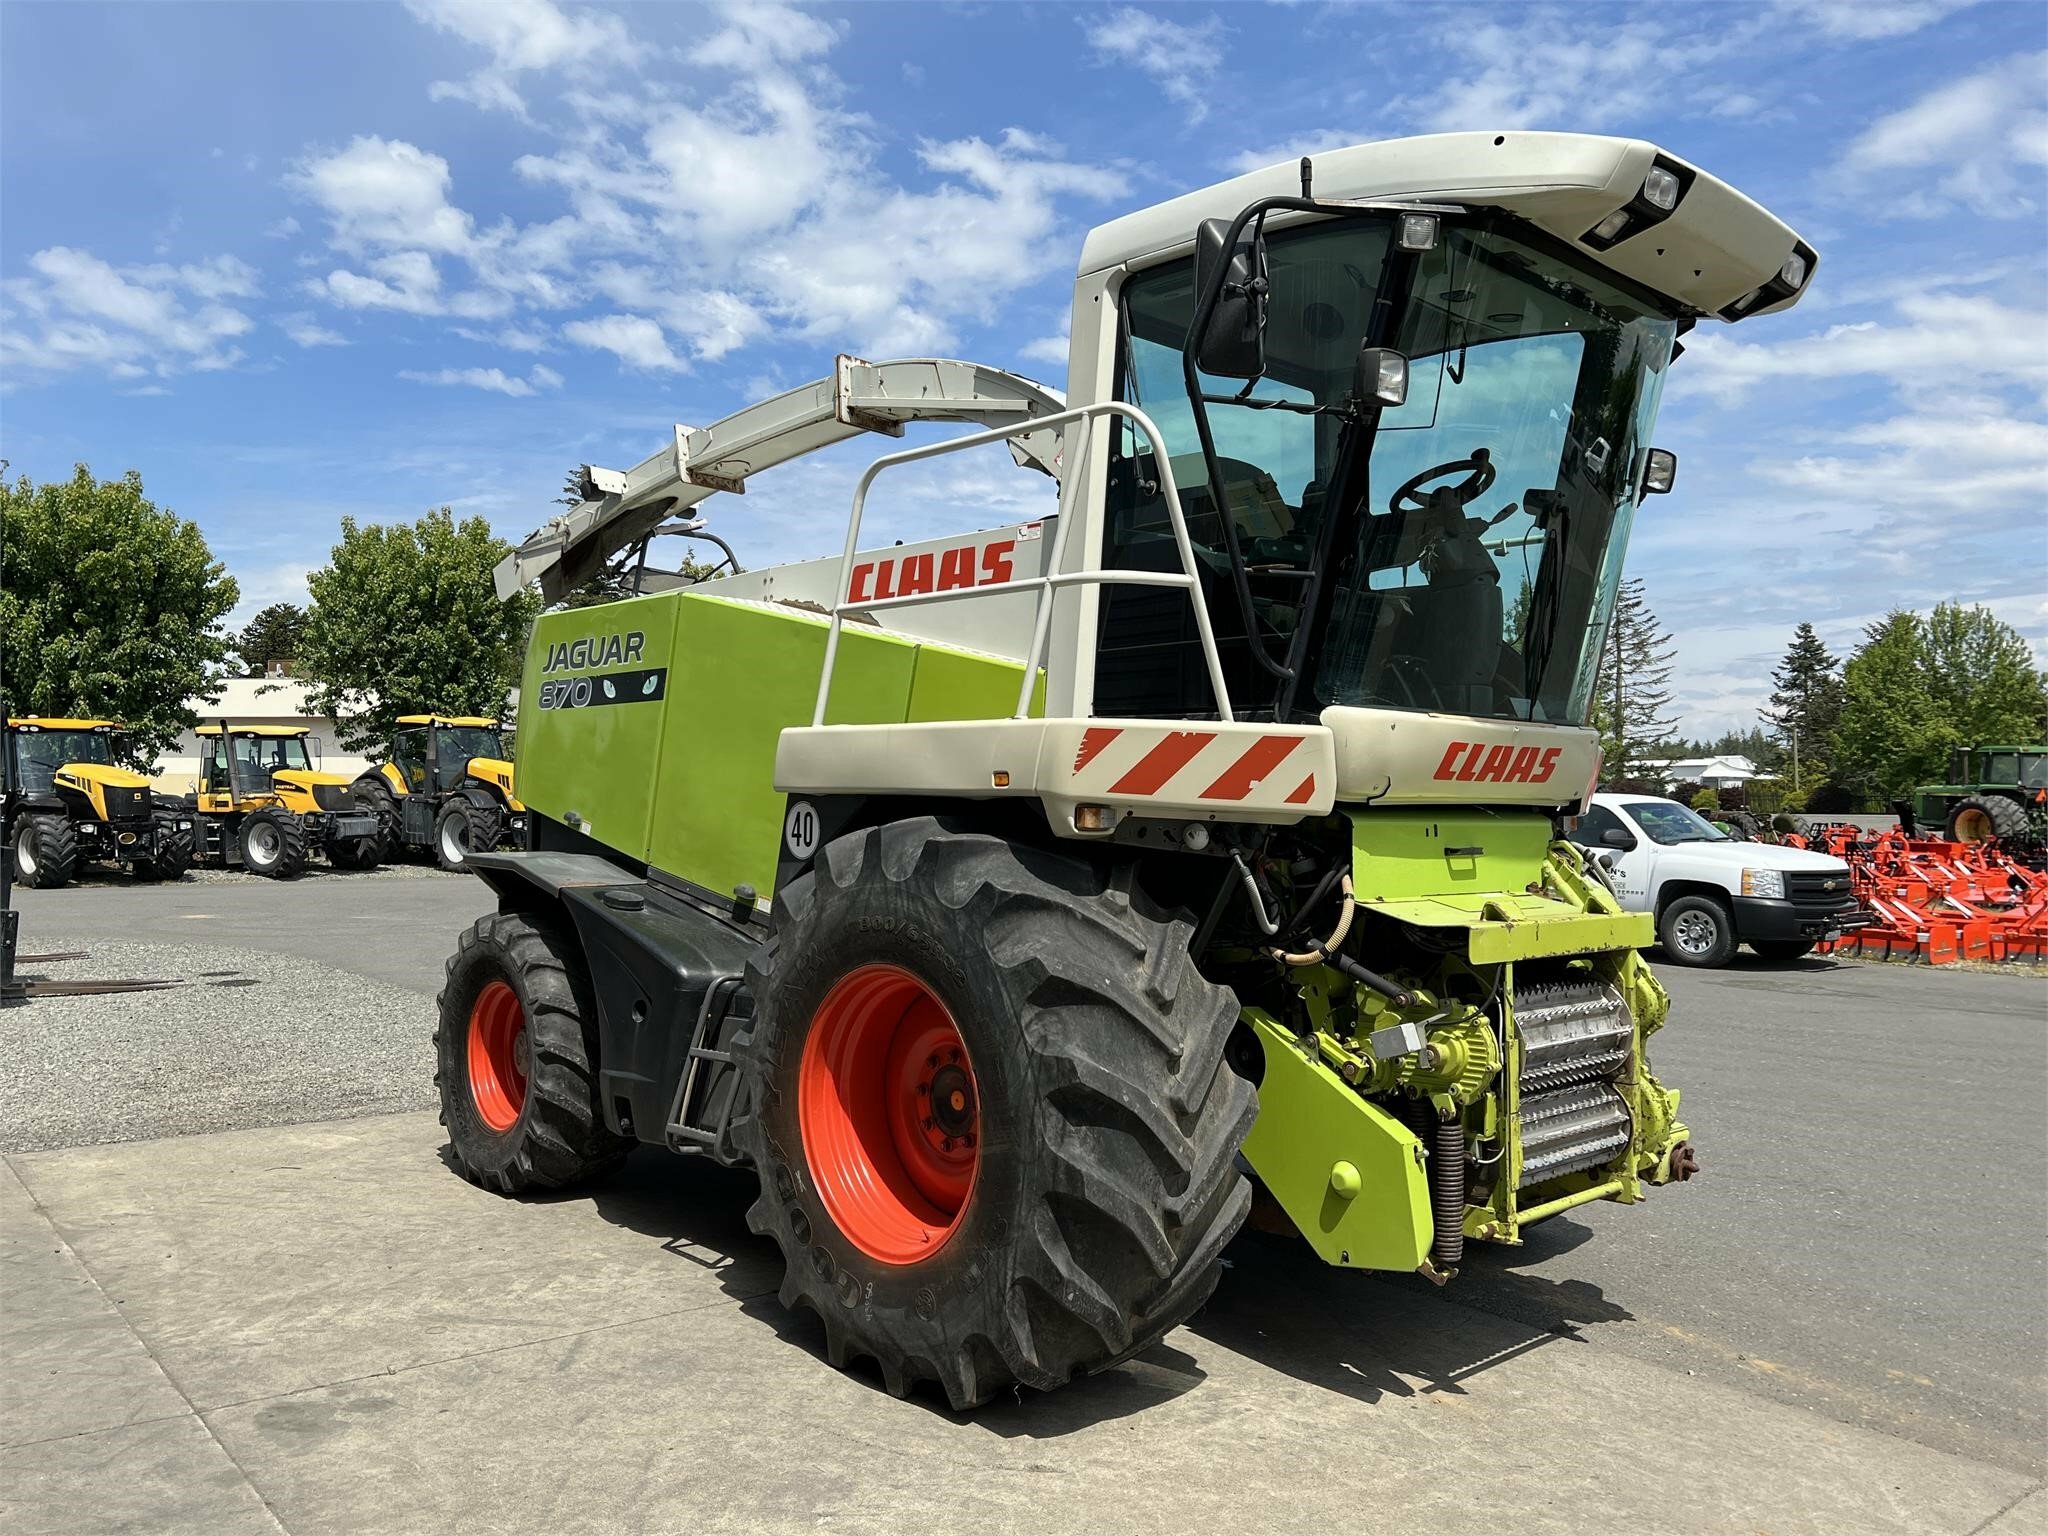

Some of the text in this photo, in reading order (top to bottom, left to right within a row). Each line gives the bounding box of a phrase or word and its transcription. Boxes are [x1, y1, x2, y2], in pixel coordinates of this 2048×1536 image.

[848, 540, 1015, 604] CLAAS
[542, 631, 646, 674] JAGUAR
[539, 676, 592, 710] 870
[1433, 742, 1562, 783] CLAAS
[791, 811, 813, 848] 40
